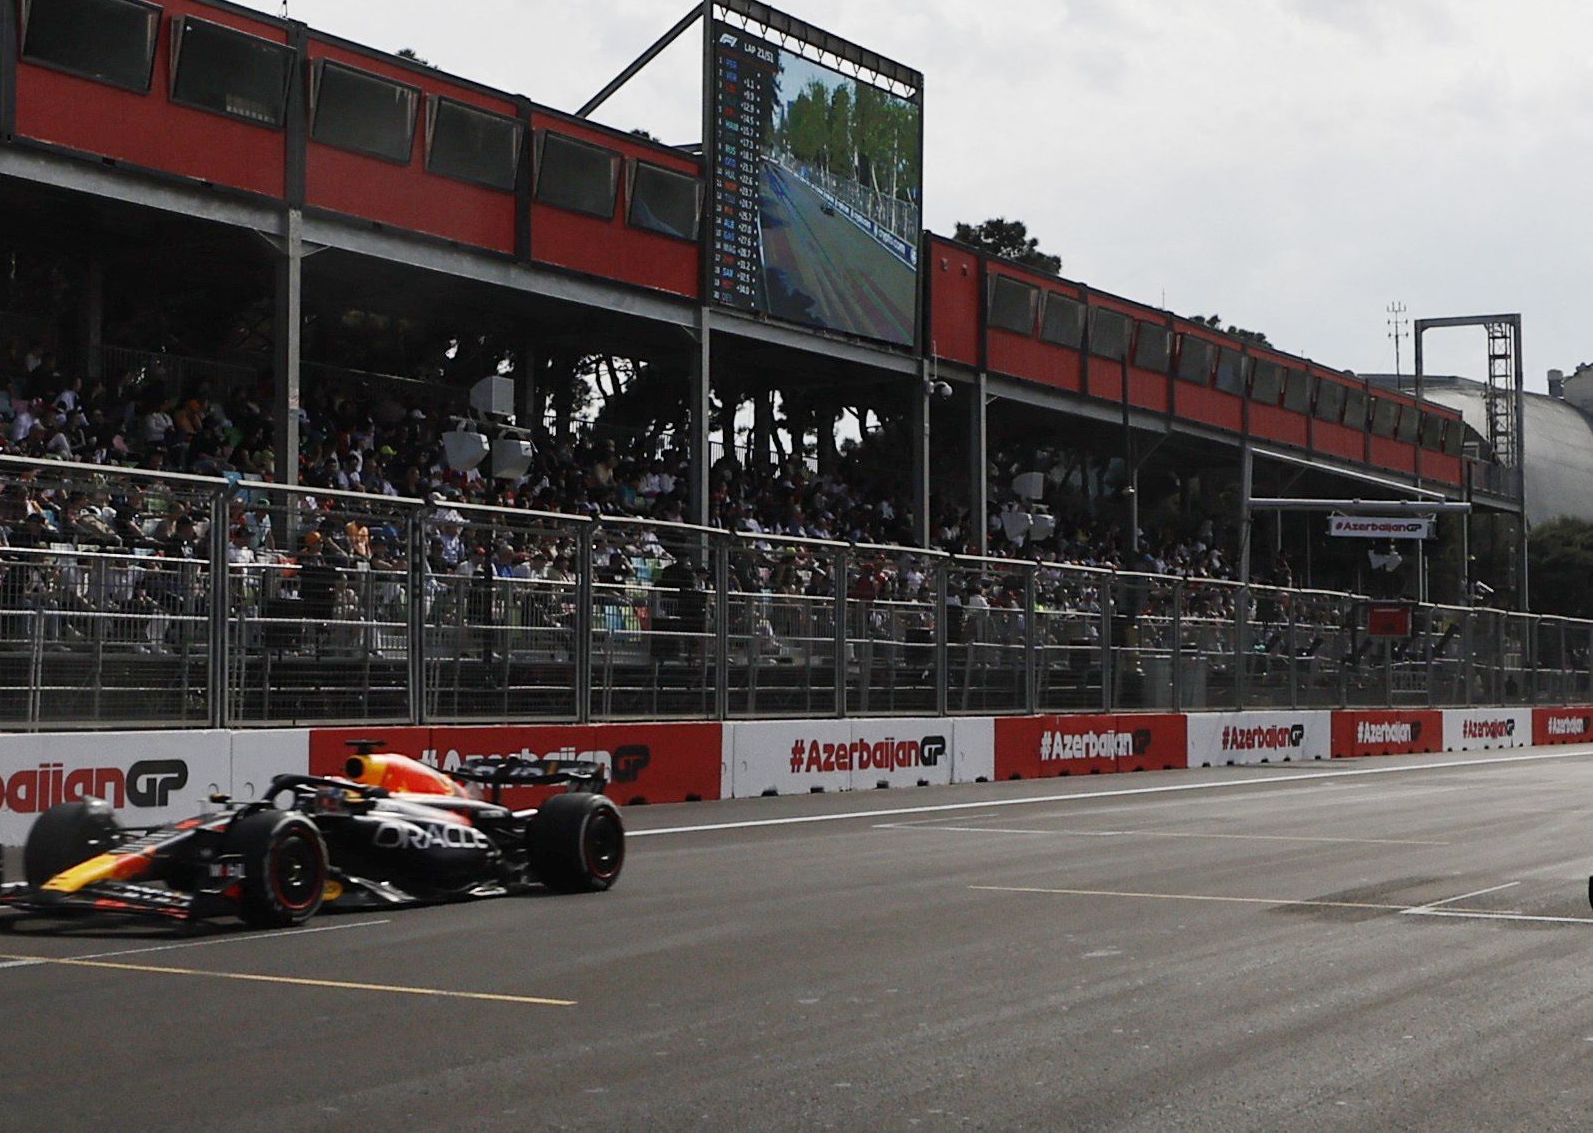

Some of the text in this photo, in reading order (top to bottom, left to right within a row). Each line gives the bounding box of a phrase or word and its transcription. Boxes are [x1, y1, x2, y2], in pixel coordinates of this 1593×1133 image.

[744, 43, 756, 54] LAP
[1335, 521, 1422, 533] #AzerbaijanGP
[1041, 728, 1152, 760] #AzerbaijanGP
[1222, 724, 1304, 751] #AzerbaijanGP
[791, 735, 946, 773] #AzerbaijanGP
[375, 822, 489, 849] ORACLE
